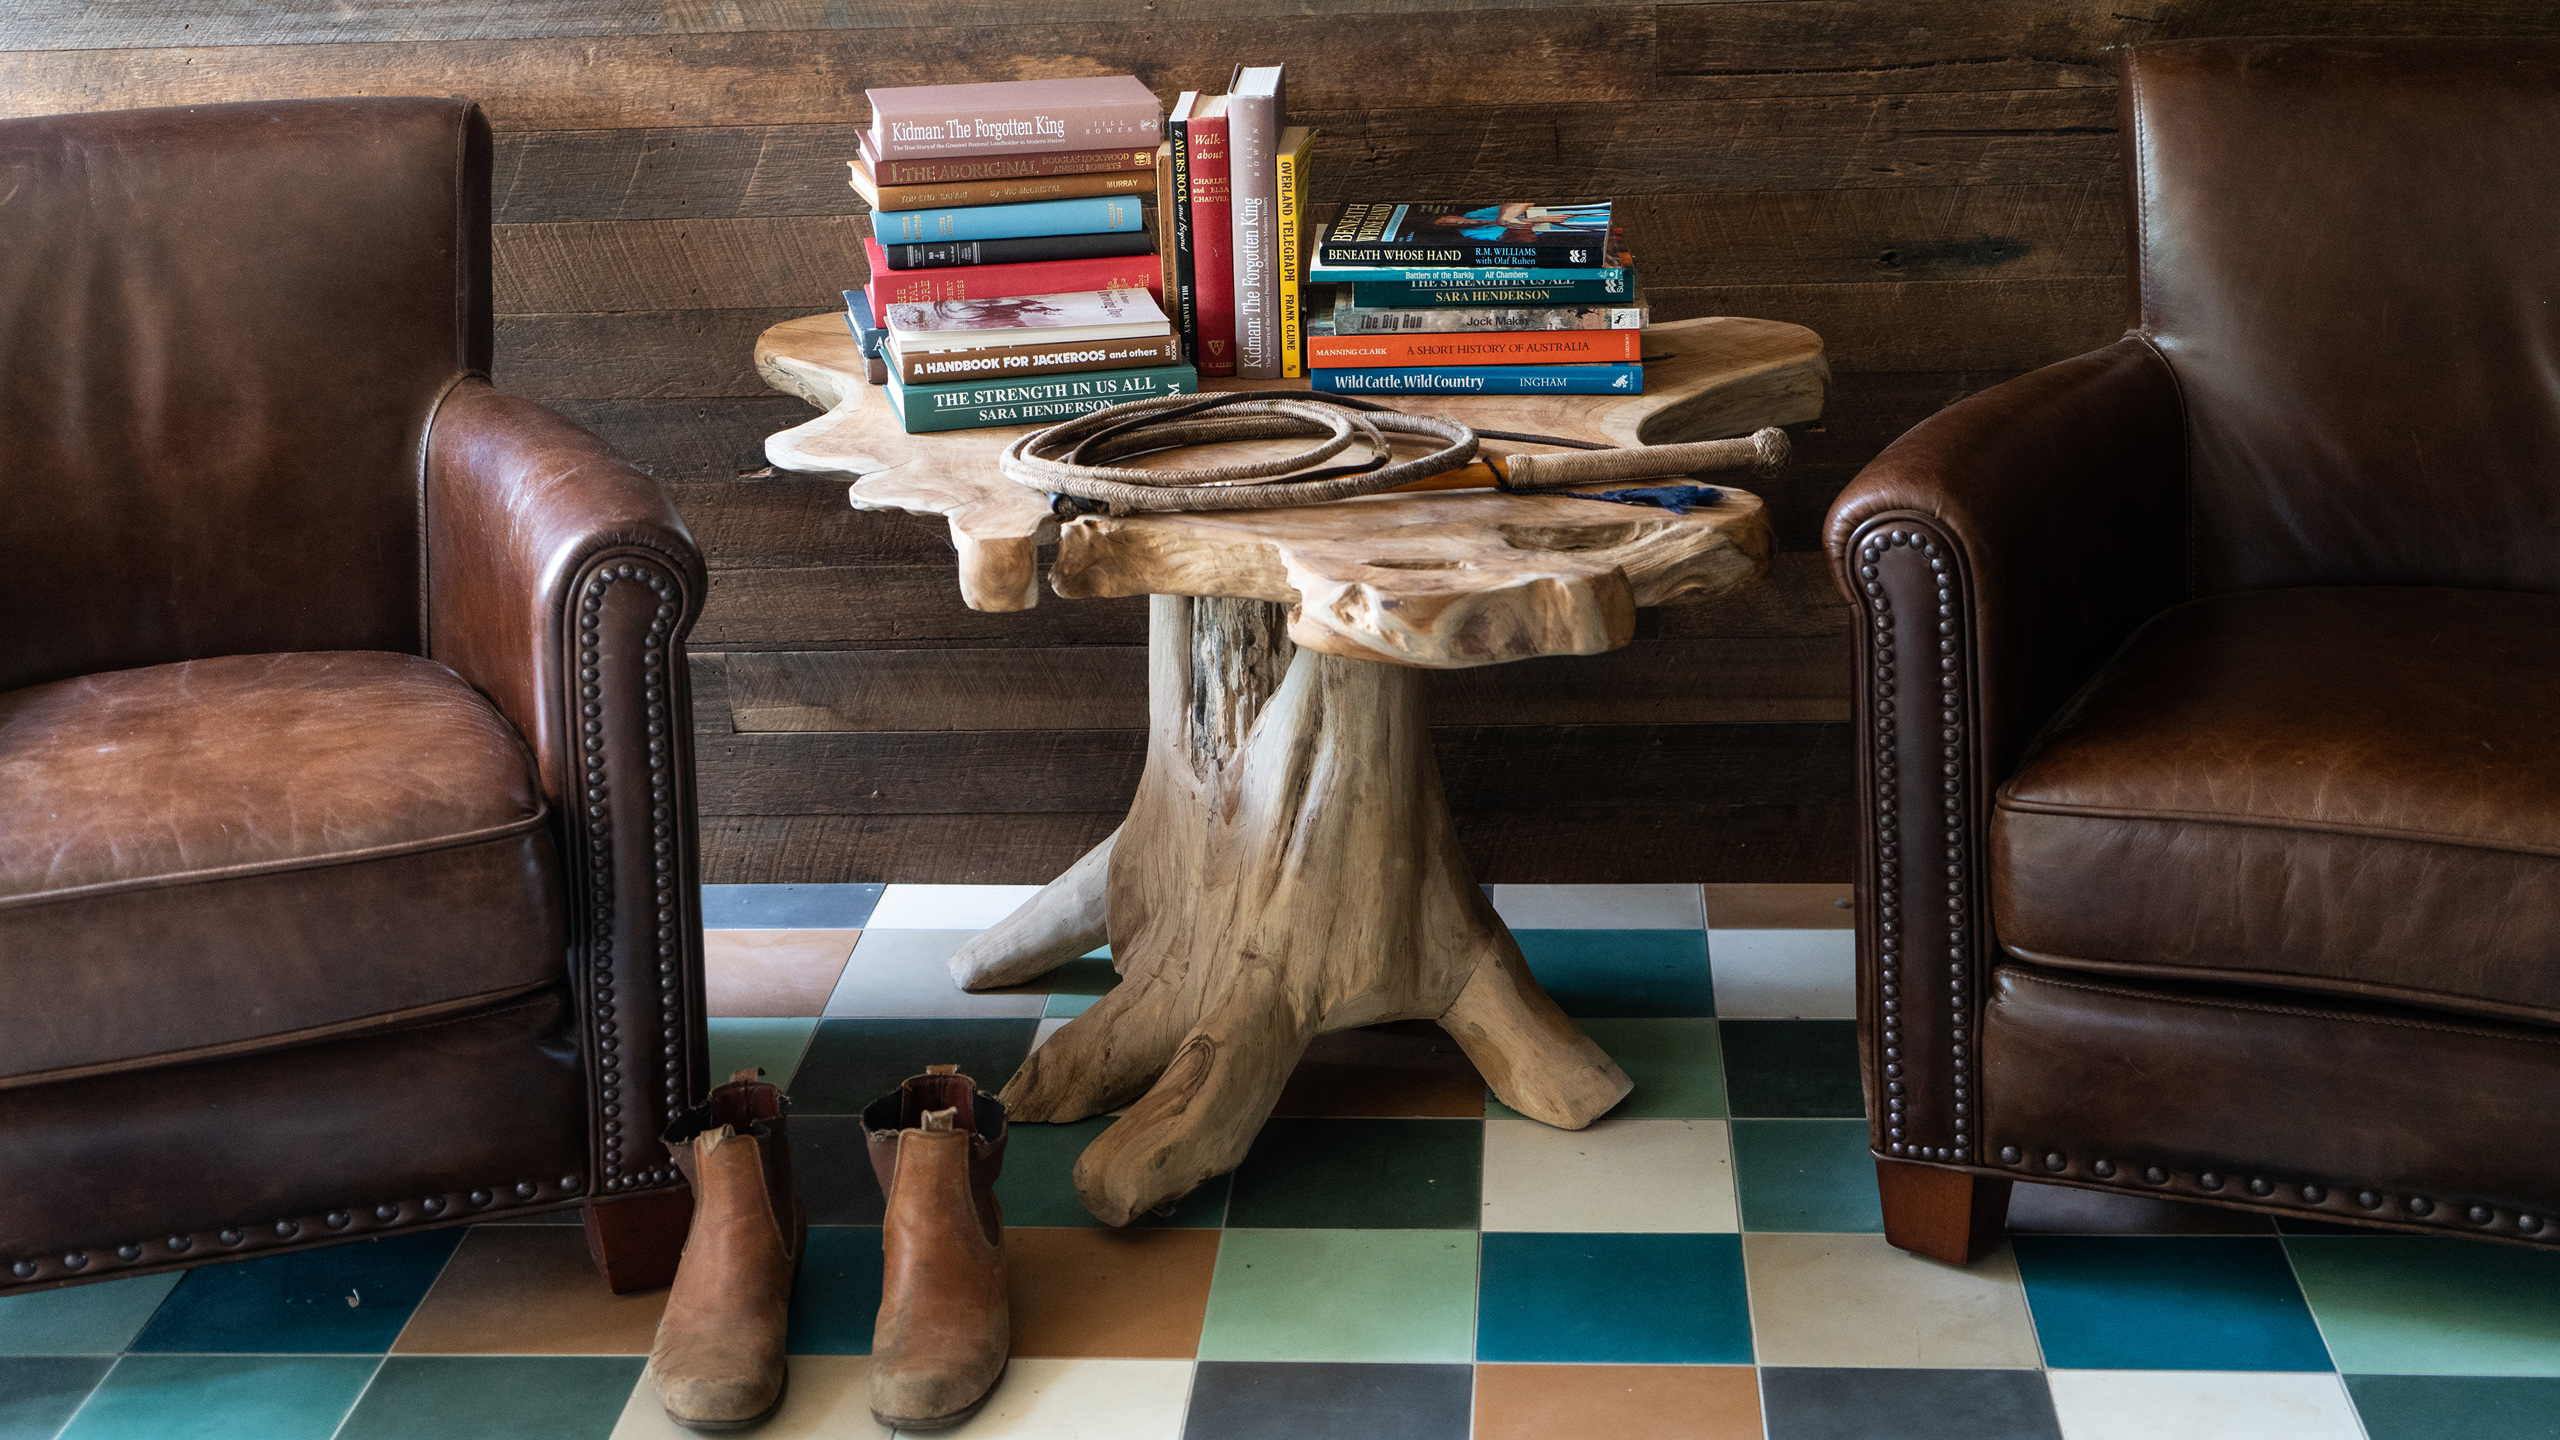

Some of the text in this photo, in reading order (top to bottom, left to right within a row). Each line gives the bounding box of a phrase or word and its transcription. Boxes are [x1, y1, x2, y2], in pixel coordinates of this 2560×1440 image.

[892, 116, 1064, 141] Kidman: The Forgotten King
[1195, 134, 1226, 145] Walk-
[1042, 153, 1130, 165] DOUGLAS LOCKWOOD
[1175, 138, 1186, 172] AYERS
[1197, 149, 1223, 159] about
[902, 166, 936, 181] THE
[939, 160, 1039, 179] ABORIGINAL
[1086, 162, 1121, 171] ROBERTS
[1019, 185, 1061, 194] McCRISTAL
[1107, 180, 1138, 188] MURRAY
[1176, 173, 1187, 203] ROCK
[940, 192, 968, 200] SAFARI
[1178, 204, 1186, 222] and
[1331, 204, 1370, 242] BENEATH
[1177, 222, 1188, 252] Beyond
[1281, 162, 1295, 351] OVERLAND TELEGRAPH FRANK CLUNE
[1328, 250, 1462, 261] BENEATH WHOSE HAND
[1475, 248, 1536, 256] R.M. WILLIAMS
[1494, 257, 1510, 265] Olaf
[1512, 257, 1535, 265] Ruhen
[1241, 198, 1264, 368] Kidman: The Forgotten King
[1432, 271, 1439, 279] of
[1441, 271, 1451, 279] the
[1453, 271, 1474, 280] Barkly
[1496, 271, 1528, 279] Chambers
[897, 289, 906, 303] HE
[909, 282, 918, 302] TAL
[921, 280, 930, 302] ORE
[1436, 290, 1550, 302] SARA HENDERSON
[1361, 314, 1422, 331] The Big Run
[1466, 316, 1529, 326] Jock Makin
[1406, 342, 1590, 355] A SHORT HISTORY OF AUSTRALIA
[914, 349, 1157, 375] A HANDBOOK FOR JACKEROOS and others
[1335, 374, 1567, 390] Wild Cattle, Wild Country INGHAM
[934, 377, 1156, 407] THE STRENGTH IN US ALL
[979, 400, 1114, 421] SARA HENDERSON
